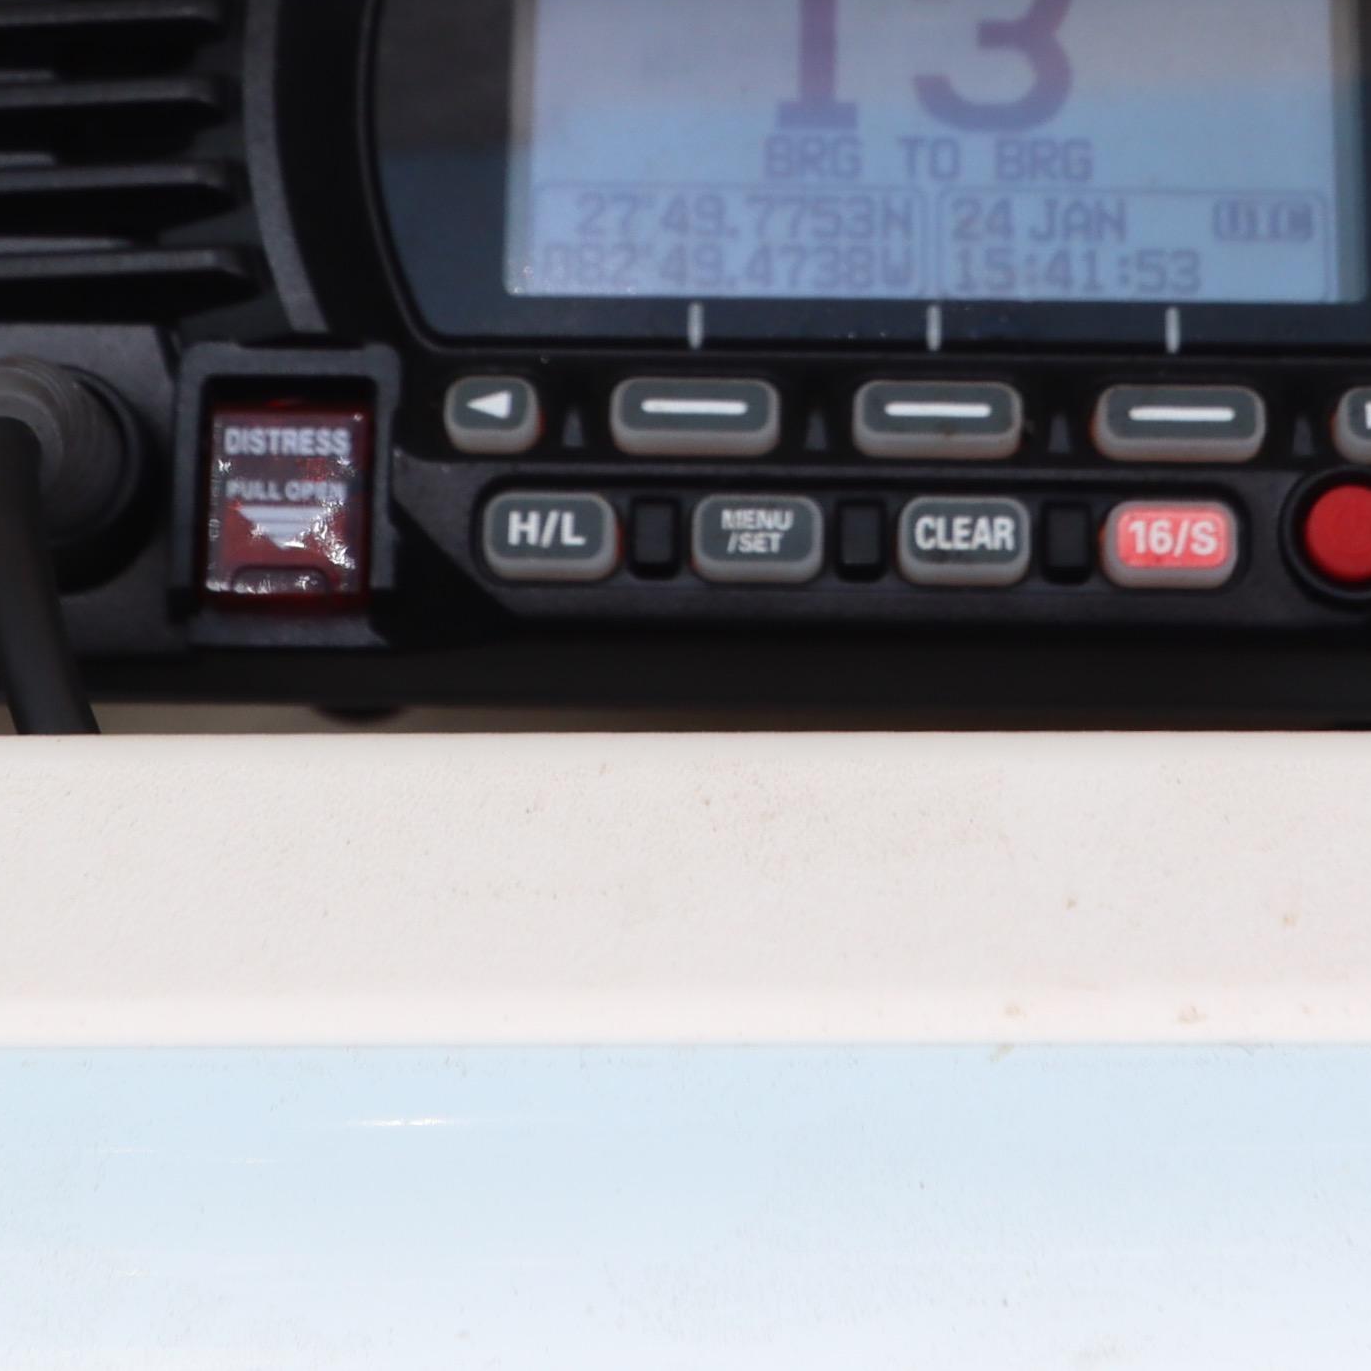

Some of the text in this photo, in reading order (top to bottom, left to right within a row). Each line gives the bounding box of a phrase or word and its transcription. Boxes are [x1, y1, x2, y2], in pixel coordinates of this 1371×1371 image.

[763, 135, 1094, 182] BRG TO BRG
[950, 197, 1015, 242] 24
[1028, 197, 1130, 243] JAN
[954, 245, 1202, 294] 15:41:53
[224, 426, 352, 457] DISTRESS
[226, 479, 348, 504] PULL OPEN
[507, 509, 587, 548] H/L
[721, 508, 794, 531] MENU
[914, 515, 1016, 551] CLEAR
[1129, 518, 1219, 558] 16/S
[726, 531, 783, 554] /SET
